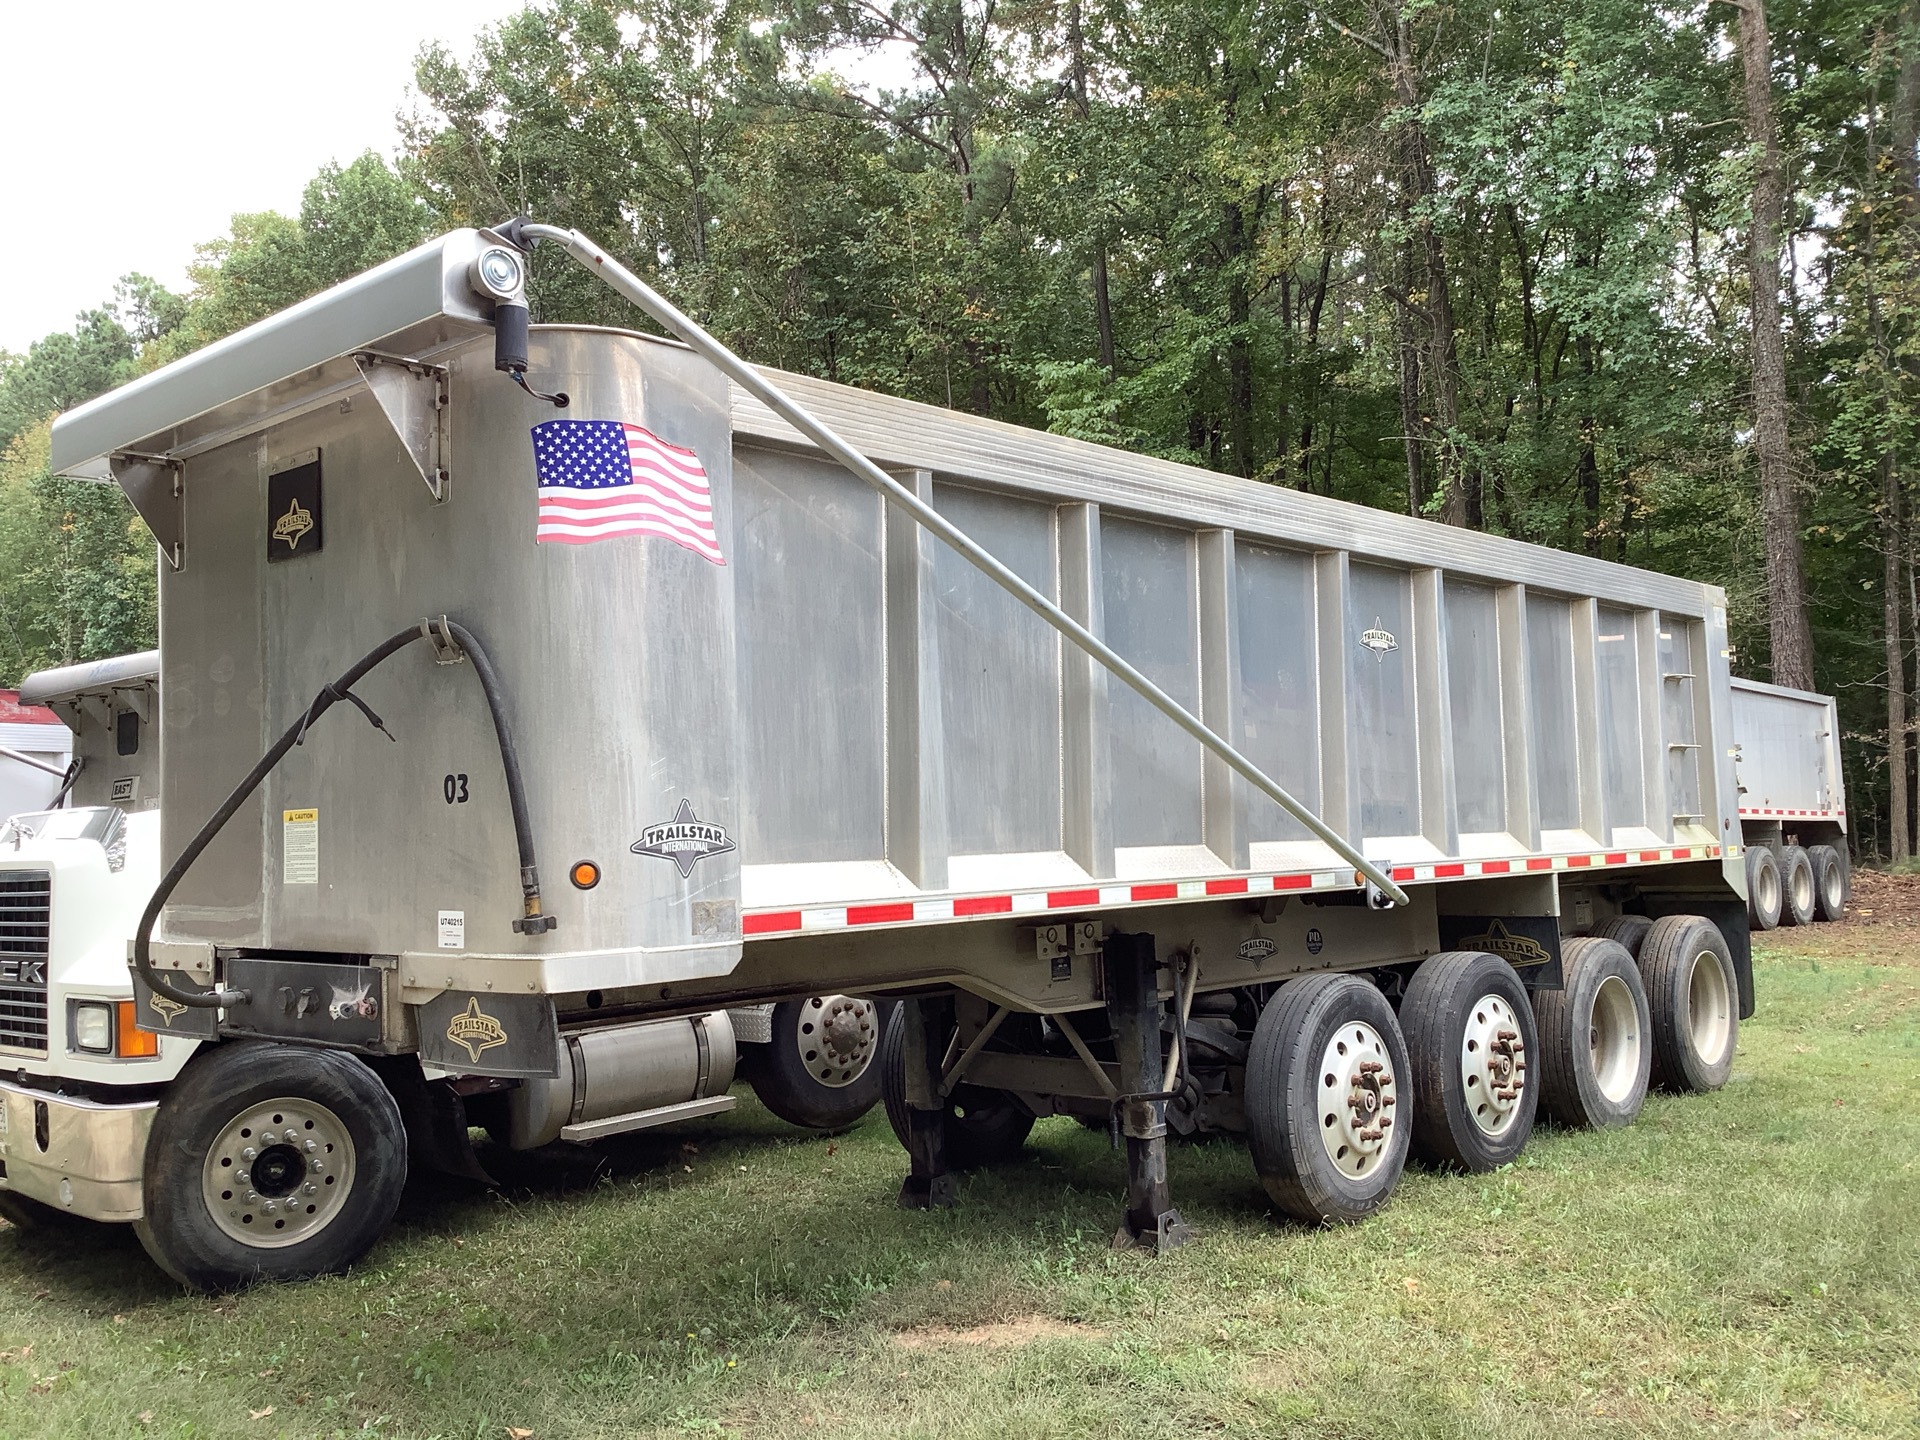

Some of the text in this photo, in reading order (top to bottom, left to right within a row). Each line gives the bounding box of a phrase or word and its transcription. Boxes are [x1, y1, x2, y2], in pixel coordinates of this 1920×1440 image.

[280, 515, 308, 531] TRAILSTAR
[1364, 632, 1393, 643] TRAILSTAR
[114, 783, 130, 795] EAST
[444, 774, 469, 804] 03
[648, 825, 722, 844] TRAILSTAR
[662, 841, 709, 853] INTERNATIONAL
[1242, 940, 1273, 953] TRAILSTAR
[1465, 941, 1534, 956] TRAILSTAR
[455, 1020, 496, 1036] TRAILSTAR
